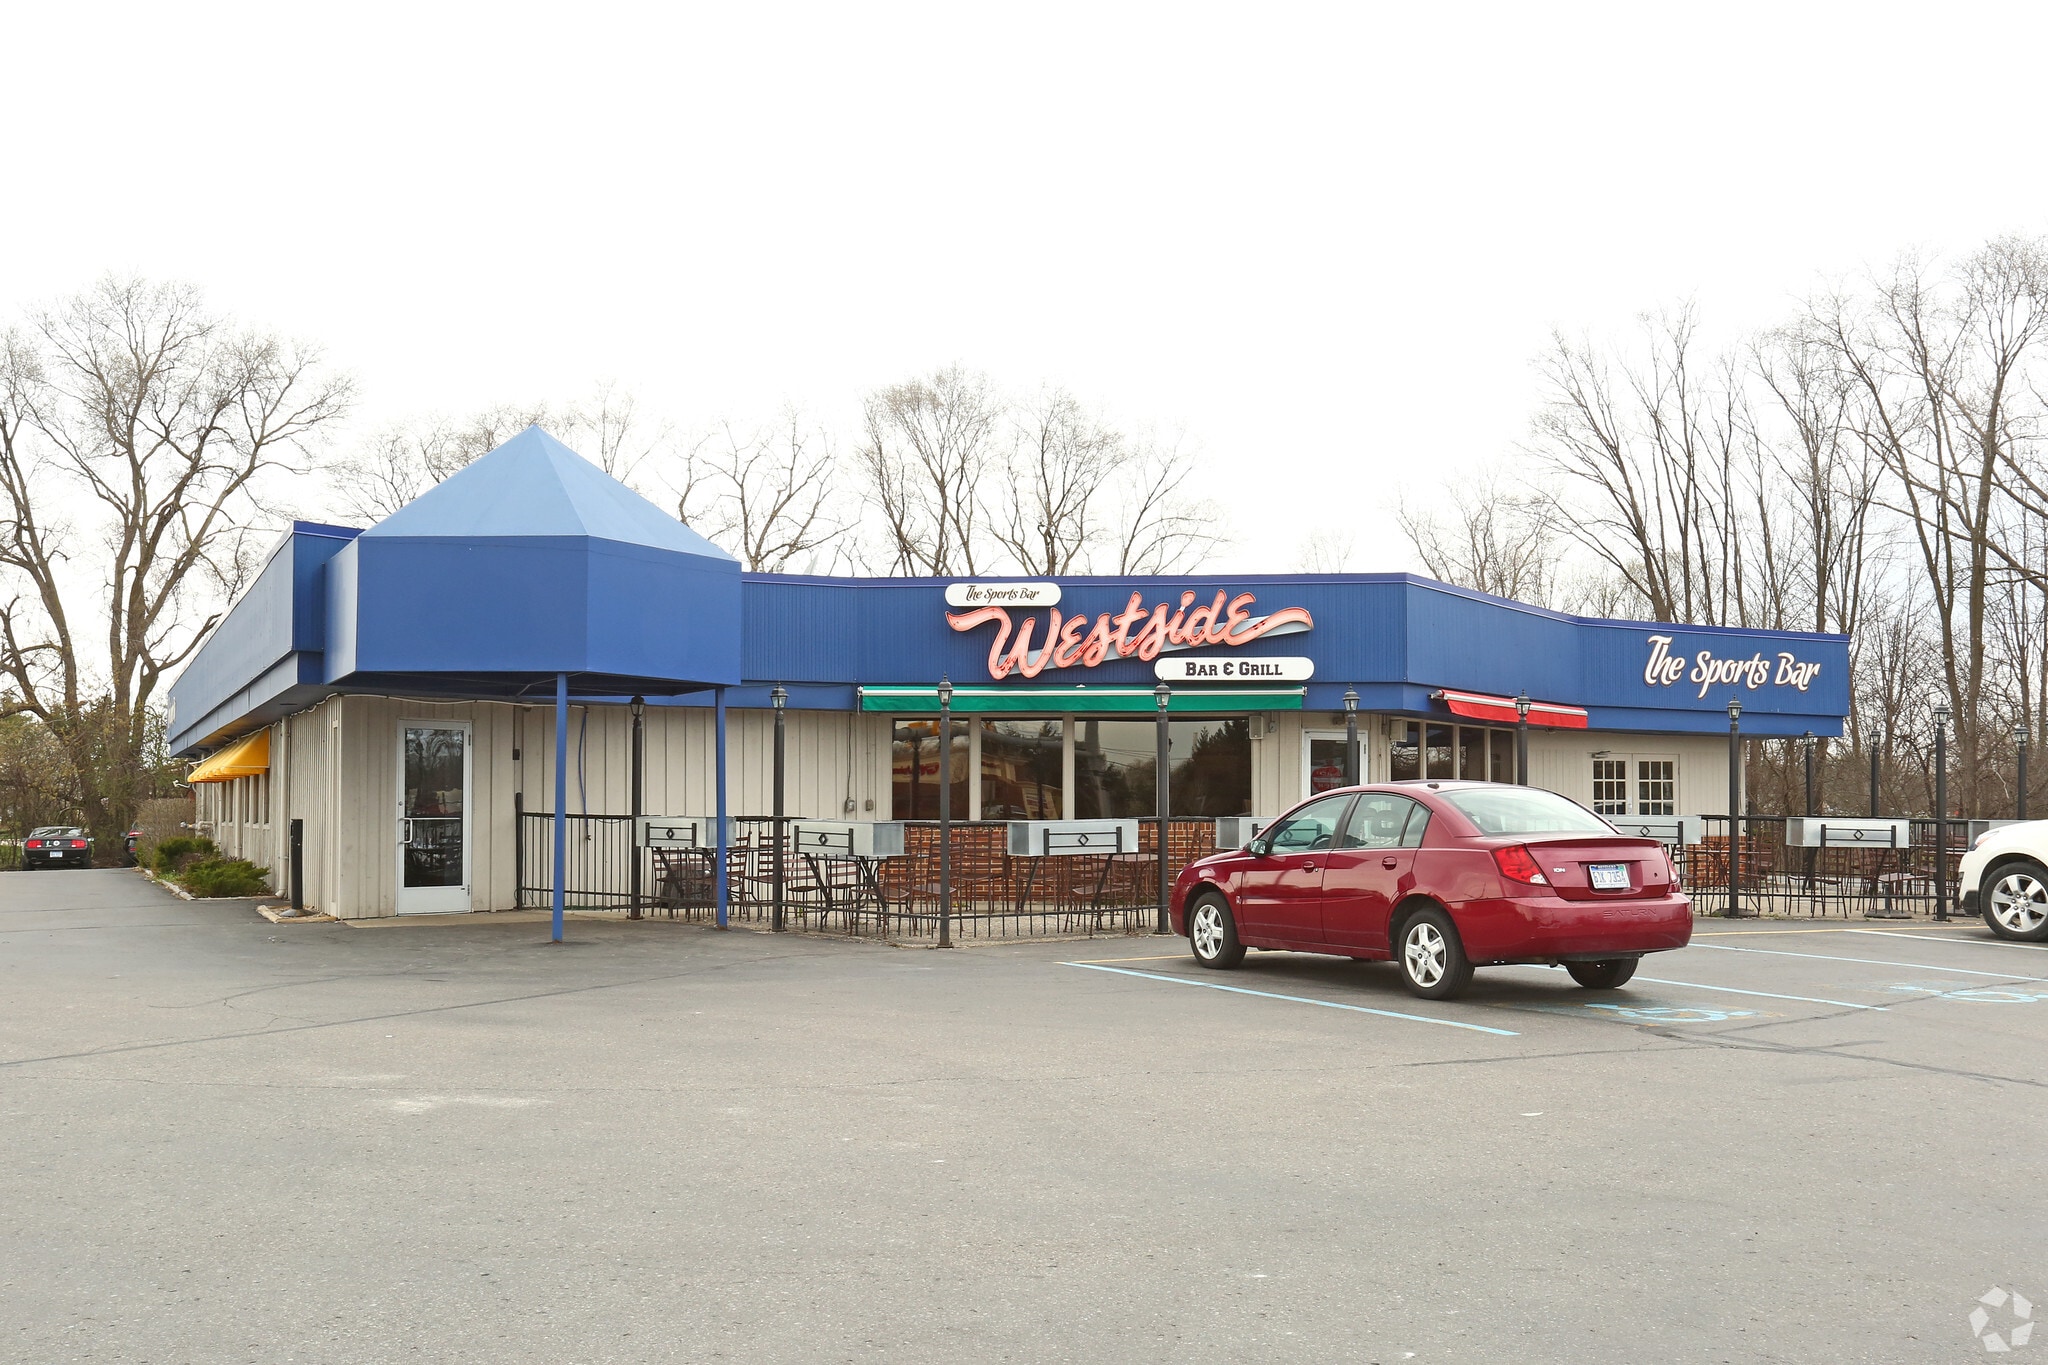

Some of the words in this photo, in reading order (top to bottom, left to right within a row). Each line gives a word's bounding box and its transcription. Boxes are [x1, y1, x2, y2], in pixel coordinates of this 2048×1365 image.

[966, 585, 982, 601] The
[984, 588, 1018, 603] Sports
[1019, 588, 1040, 600] Bar
[945, 589, 1313, 680] Westside
[1644, 634, 1686, 687] The
[1689, 650, 1771, 700] Sports
[1774, 652, 1821, 692] Bar
[1603, 908, 1657, 919] SATURN
